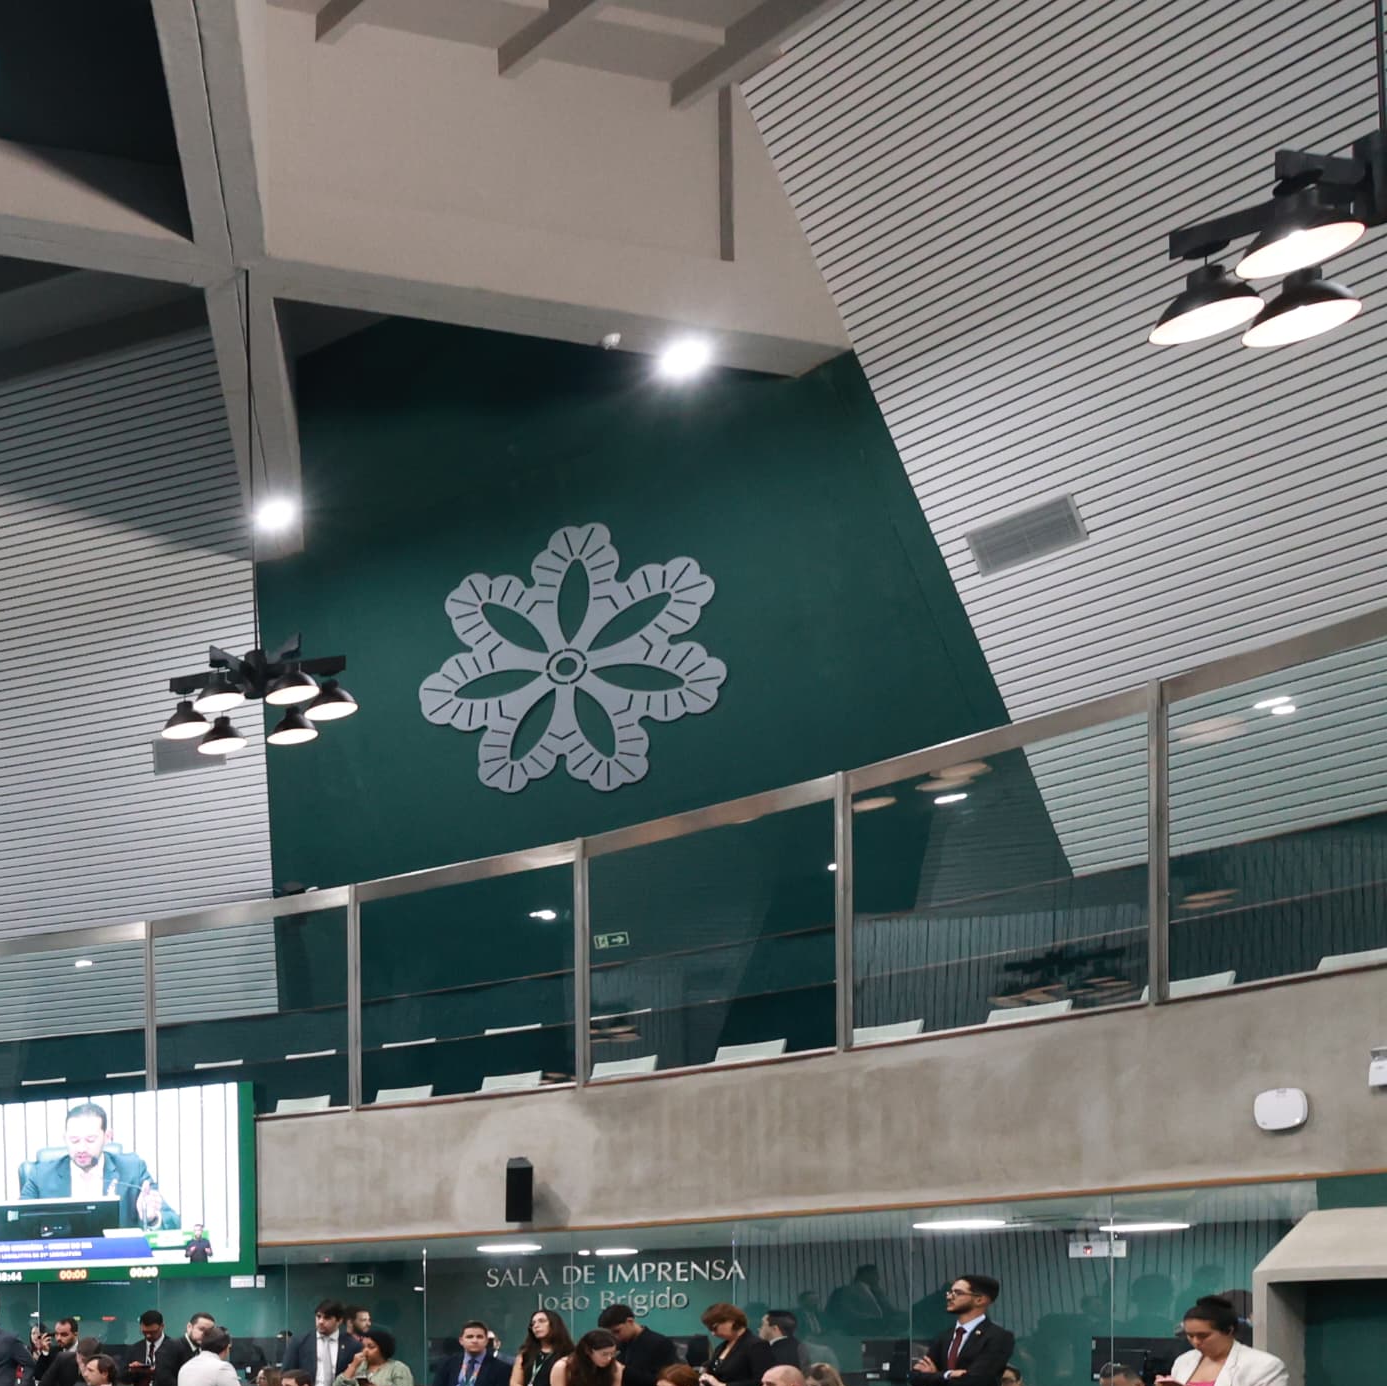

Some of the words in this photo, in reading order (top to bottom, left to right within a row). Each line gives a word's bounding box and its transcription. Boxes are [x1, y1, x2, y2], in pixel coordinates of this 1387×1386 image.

[59, 1269, 87, 1280] 00:00
[486, 1267, 549, 1287] SALA
[562, 1265, 596, 1284] DE
[608, 1260, 746, 1283] IMPRENSA
[537, 1291, 589, 1312] João
[600, 1286, 688, 1317] Brígido
